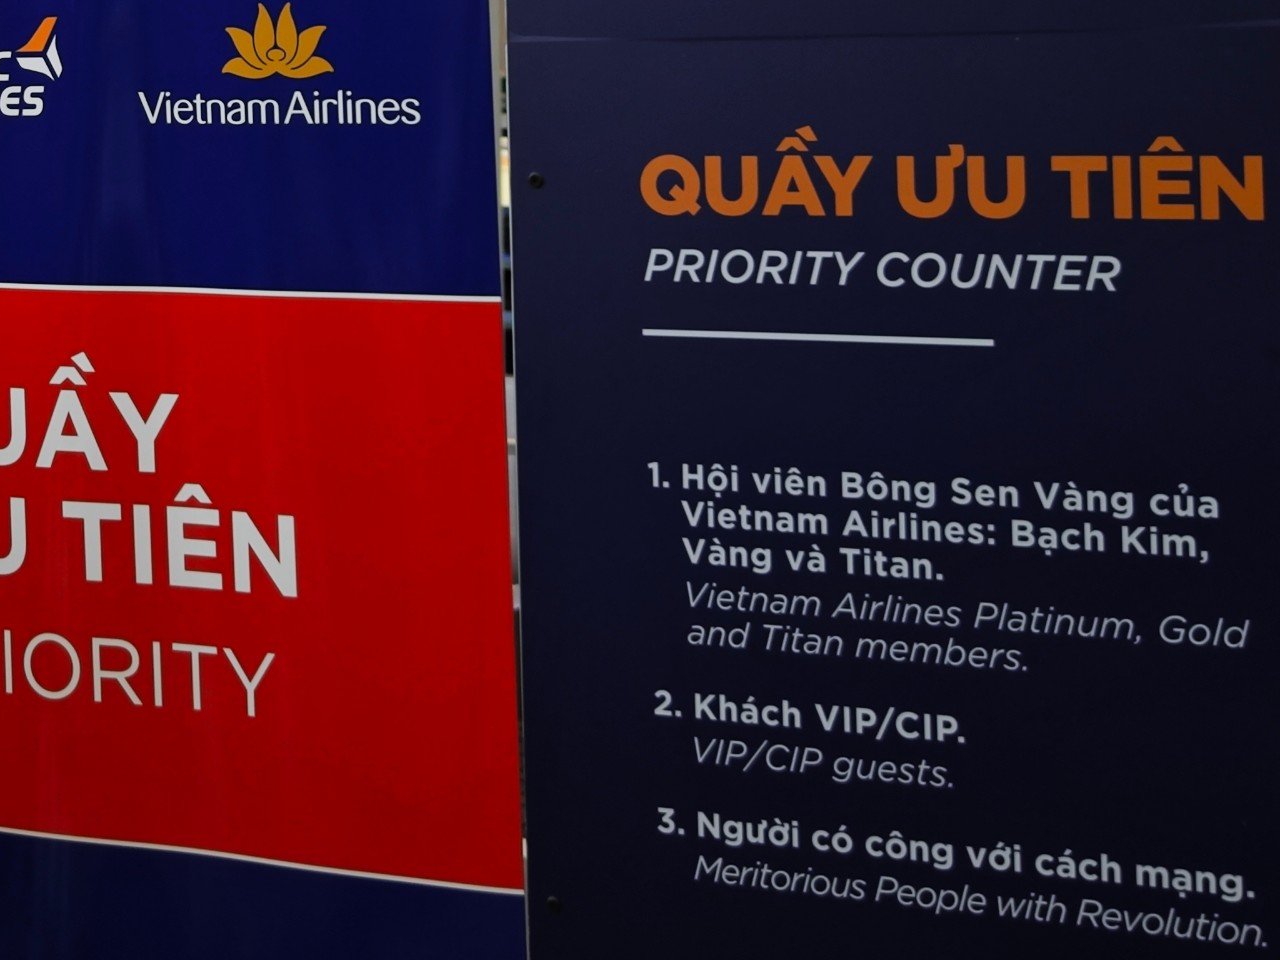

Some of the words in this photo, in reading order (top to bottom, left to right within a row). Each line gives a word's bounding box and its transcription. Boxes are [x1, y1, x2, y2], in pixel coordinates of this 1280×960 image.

[137, 91, 279, 126] Vietnam
[285, 89, 421, 125] Airlines
[639, 124, 874, 218] QUẦY
[895, 143, 1027, 220] ƯU
[1050, 135, 1266, 222] TIÊN
[643, 248, 866, 286] PRIORITY
[875, 251, 1121, 292] COUNTER
[647, 462, 670, 488] 1.
[681, 463, 739, 495] Hội
[752, 467, 827, 498] viên
[841, 471, 936, 508] Bông
[951, 477, 1020, 508] Sen
[1034, 481, 1135, 518] Vàng
[1149, 482, 1220, 518] của
[61, 482, 298, 599] TIÊN
[681, 501, 828, 535] Vietnam
[842, 510, 996, 545] Airlines:
[1011, 520, 1105, 556] Bạch
[1121, 526, 1209, 563] Kim,
[681, 537, 772, 574] Vàng
[786, 543, 826, 573] và
[839, 547, 944, 581] Titan.
[684, 581, 821, 617] Vietnam
[832, 592, 962, 628] Airlines
[973, 602, 1142, 645] Platinum,
[1157, 616, 1250, 649] Gold
[687, 621, 748, 650] and
[762, 624, 843, 656] Titan
[854, 636, 1029, 672] members.
[653, 689, 682, 718] 2.
[693, 692, 802, 728] Khách
[814, 702, 966, 743] VIP/CIP.
[692, 737, 822, 774] VIP/CIP
[833, 756, 955, 788] guests.
[657, 806, 685, 835] 3.
[696, 810, 799, 848] Người
[811, 823, 853, 854] có
[865, 829, 954, 870] công
[966, 840, 1022, 873] với
[1034, 847, 1122, 884] cách
[1135, 860, 1256, 903] mạng.
[693, 854, 866, 900] Meritorious
[874, 875, 987, 915] People
[996, 891, 1067, 923] with
[1076, 899, 1268, 948] Revolution.
